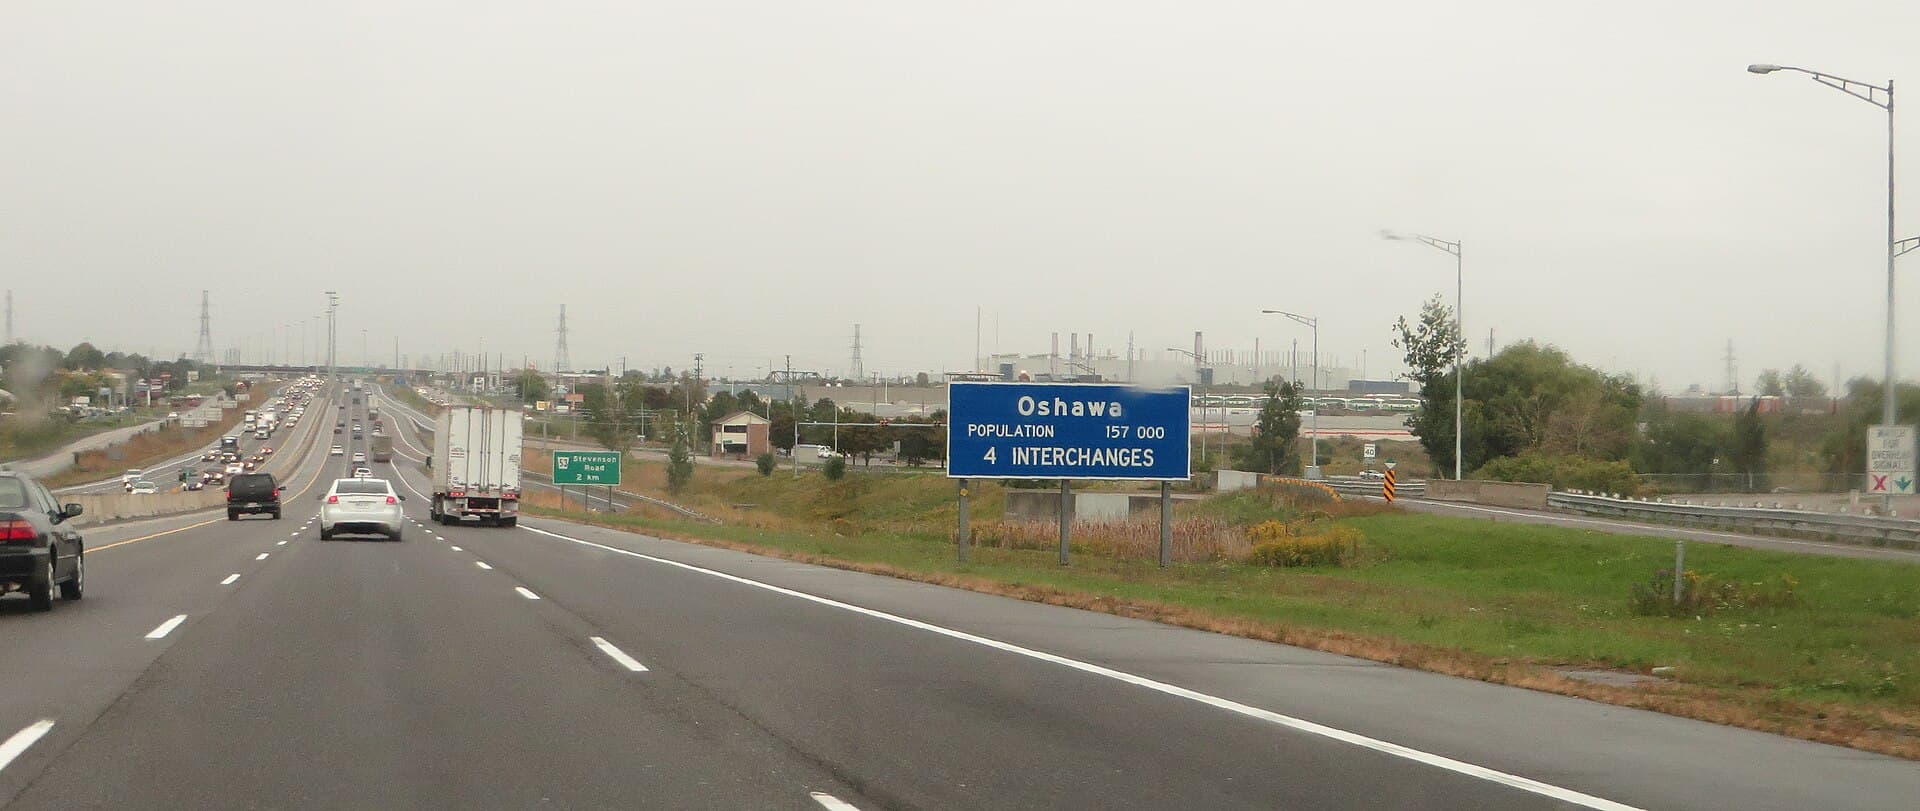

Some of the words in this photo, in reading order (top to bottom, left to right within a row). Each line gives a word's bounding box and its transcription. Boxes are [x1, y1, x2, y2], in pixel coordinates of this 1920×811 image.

[1018, 396, 1122, 417] Oshawa
[968, 424, 1054, 438] POPULATION
[1106, 425, 1129, 439] 157
[1137, 426, 1164, 440] 000
[983, 447, 997, 464] 4
[1012, 447, 1154, 467] INTERCHANGES
